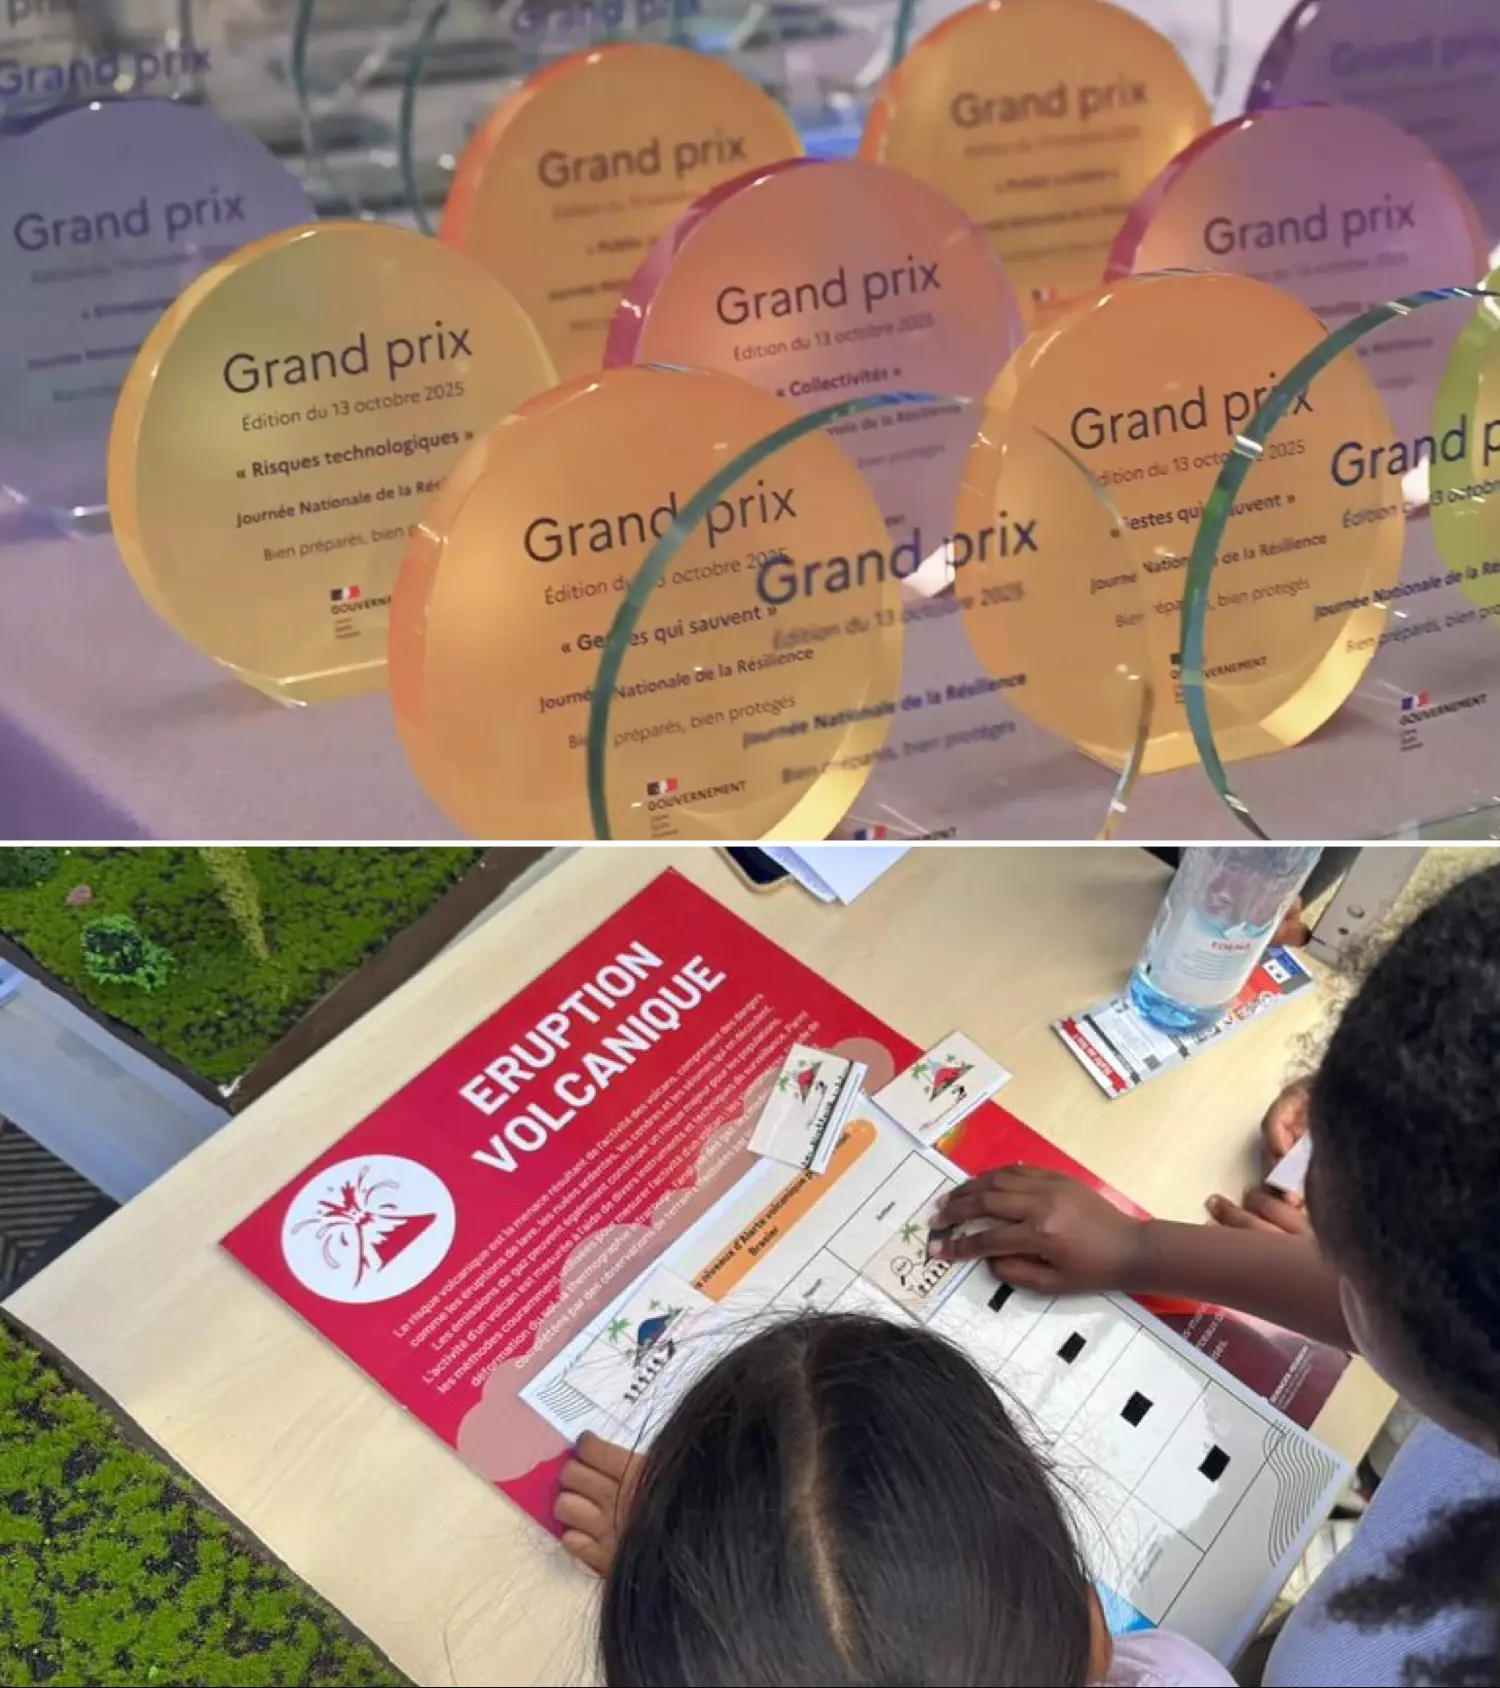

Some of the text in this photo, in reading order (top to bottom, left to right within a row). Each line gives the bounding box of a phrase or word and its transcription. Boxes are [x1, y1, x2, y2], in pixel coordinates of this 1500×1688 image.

[952, 73, 1146, 129] Grand prix
[538, 126, 747, 188] Grand prix
[14, 186, 245, 251] Grand prix
[1203, 194, 1416, 254] Grand prix
[716, 254, 941, 325] Grand prix
[223, 320, 472, 393] Grand prix
[791, 336, 811, 352] du
[815, 331, 831, 346] 13
[834, 321, 894, 344] octobre
[242, 381, 465, 432] Édition du 13 octobre 2025
[789, 366, 888, 397] Collectivités
[1070, 385, 1207, 450] Grand
[236, 430, 459, 479] « Risques technologiques
[1148, 439, 1305, 477] du 13 2025
[1331, 414, 1467, 487] Grand
[236, 505, 295, 528] Journée
[300, 491, 372, 515] Nationale
[376, 486, 395, 502] de
[398, 484, 412, 497] la
[524, 479, 797, 563] Grand prix
[263, 546, 295, 561] Bien
[372, 525, 404, 542] bien
[757, 509, 1038, 605] Grand prix
[1222, 534, 1328, 565] de la Résilience
[544, 557, 742, 606] Édition octobre
[1217, 576, 1311, 606] bien protégés
[1313, 595, 1370, 622] Journée
[1372, 574, 1442, 603] Nationale
[1444, 569, 1464, 587] de
[1466, 565, 1479, 580] la
[653, 606, 762, 644] qui sauvent
[694, 667, 714, 685] de
[718, 662, 732, 678] la
[736, 647, 814, 674] Résilience
[690, 709, 725, 729] bien
[729, 693, 796, 725] protégés
[647, 780, 747, 812] GOUVERNEMENT
[459, 941, 662, 1115] ERUPTION
[472, 954, 727, 1173] VOLCANIQUE
[392, 1319, 412, 1338] Le
[405, 1292, 441, 1326] risque
[435, 1246, 491, 1298] volcanique
[486, 1233, 505, 1251] est
[408, 1309, 449, 1348] comme
[443, 1295, 464, 1315] les
[458, 1254, 508, 1300] éruptions
[502, 1242, 520, 1260] de
[484, 1289, 521, 1324] volcan
[530, 1238, 575, 1279] mesurée
[430, 1328, 455, 1351] Les
[449, 1285, 500, 1333] émissions
[496, 1272, 514, 1290] de
[436, 1275, 561, 1395] les méthodes couramment
